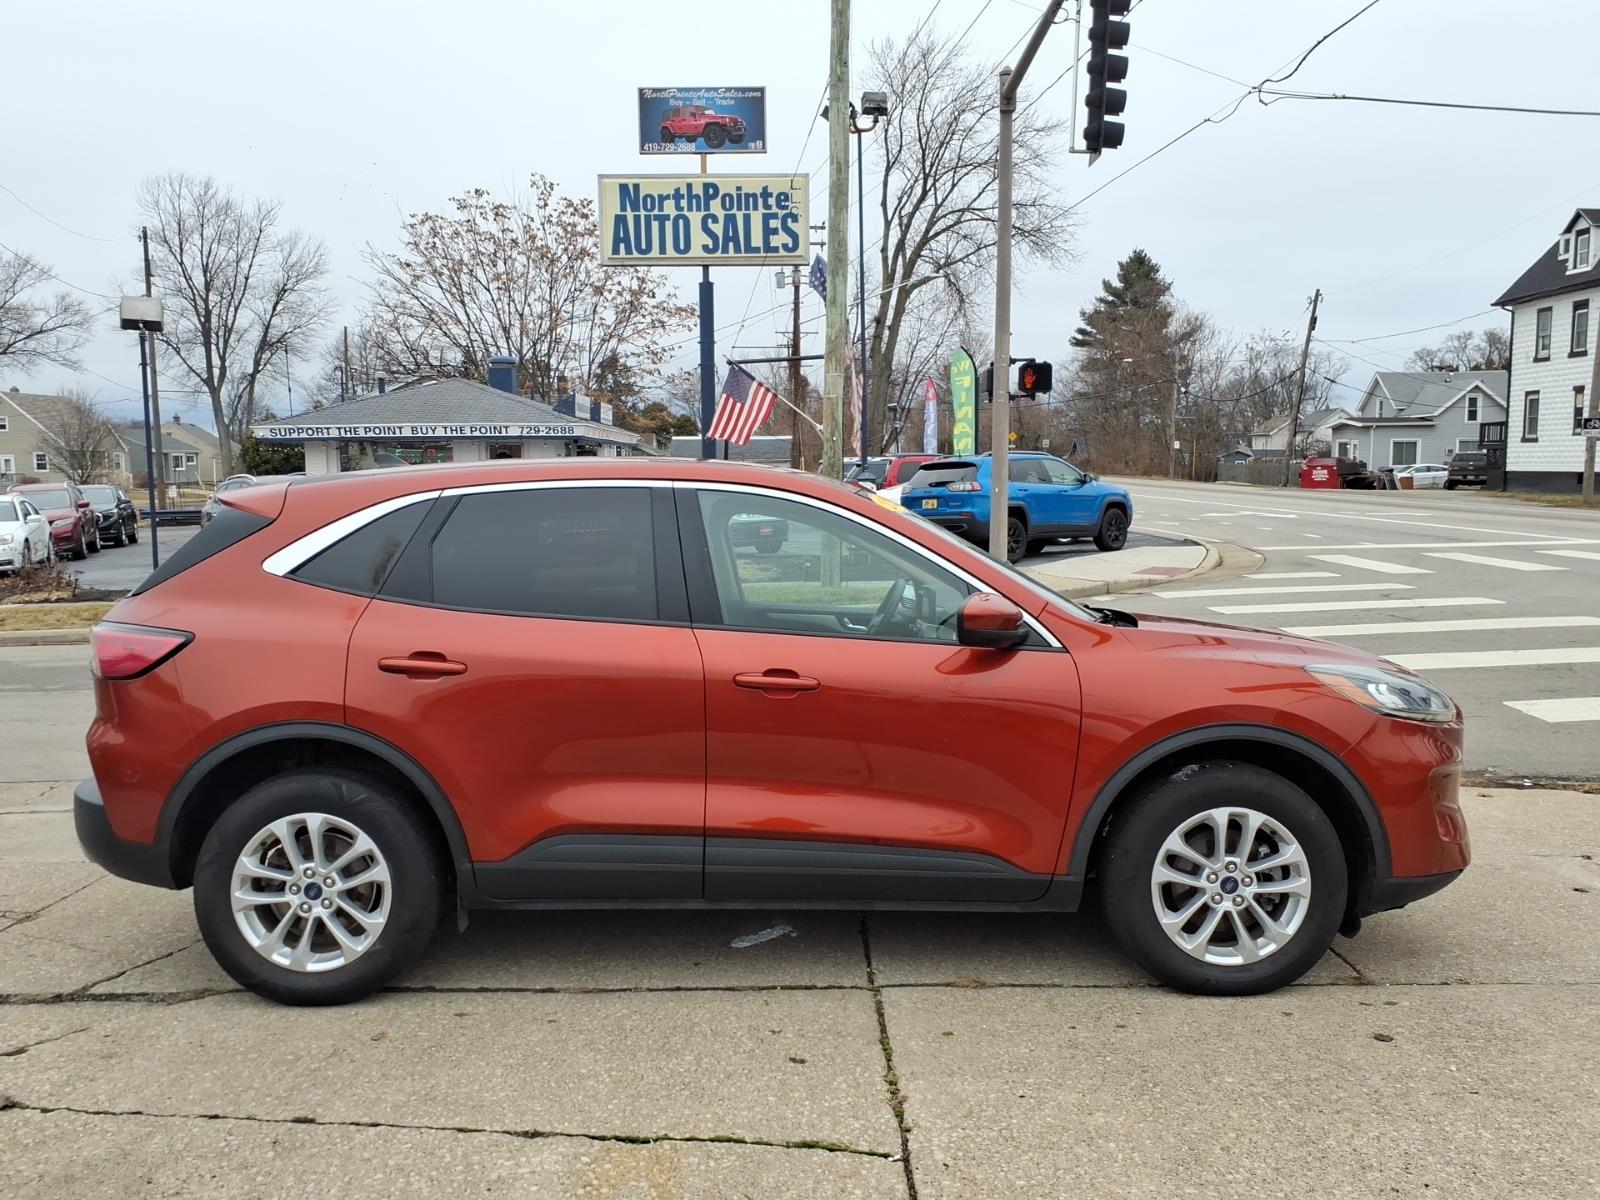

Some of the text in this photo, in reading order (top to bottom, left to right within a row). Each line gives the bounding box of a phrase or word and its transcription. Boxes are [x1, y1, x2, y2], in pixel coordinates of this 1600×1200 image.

[642, 88, 762, 98] NorthPointeAutoSales.com
[643, 143, 696, 151] 419-729-2688
[618, 183, 790, 213] NorthPointe
[611, 212, 800, 256] AUTO SALES
[269, 425, 575, 438] SUPPORT THE POINT BUY THE POINT 729-2688
